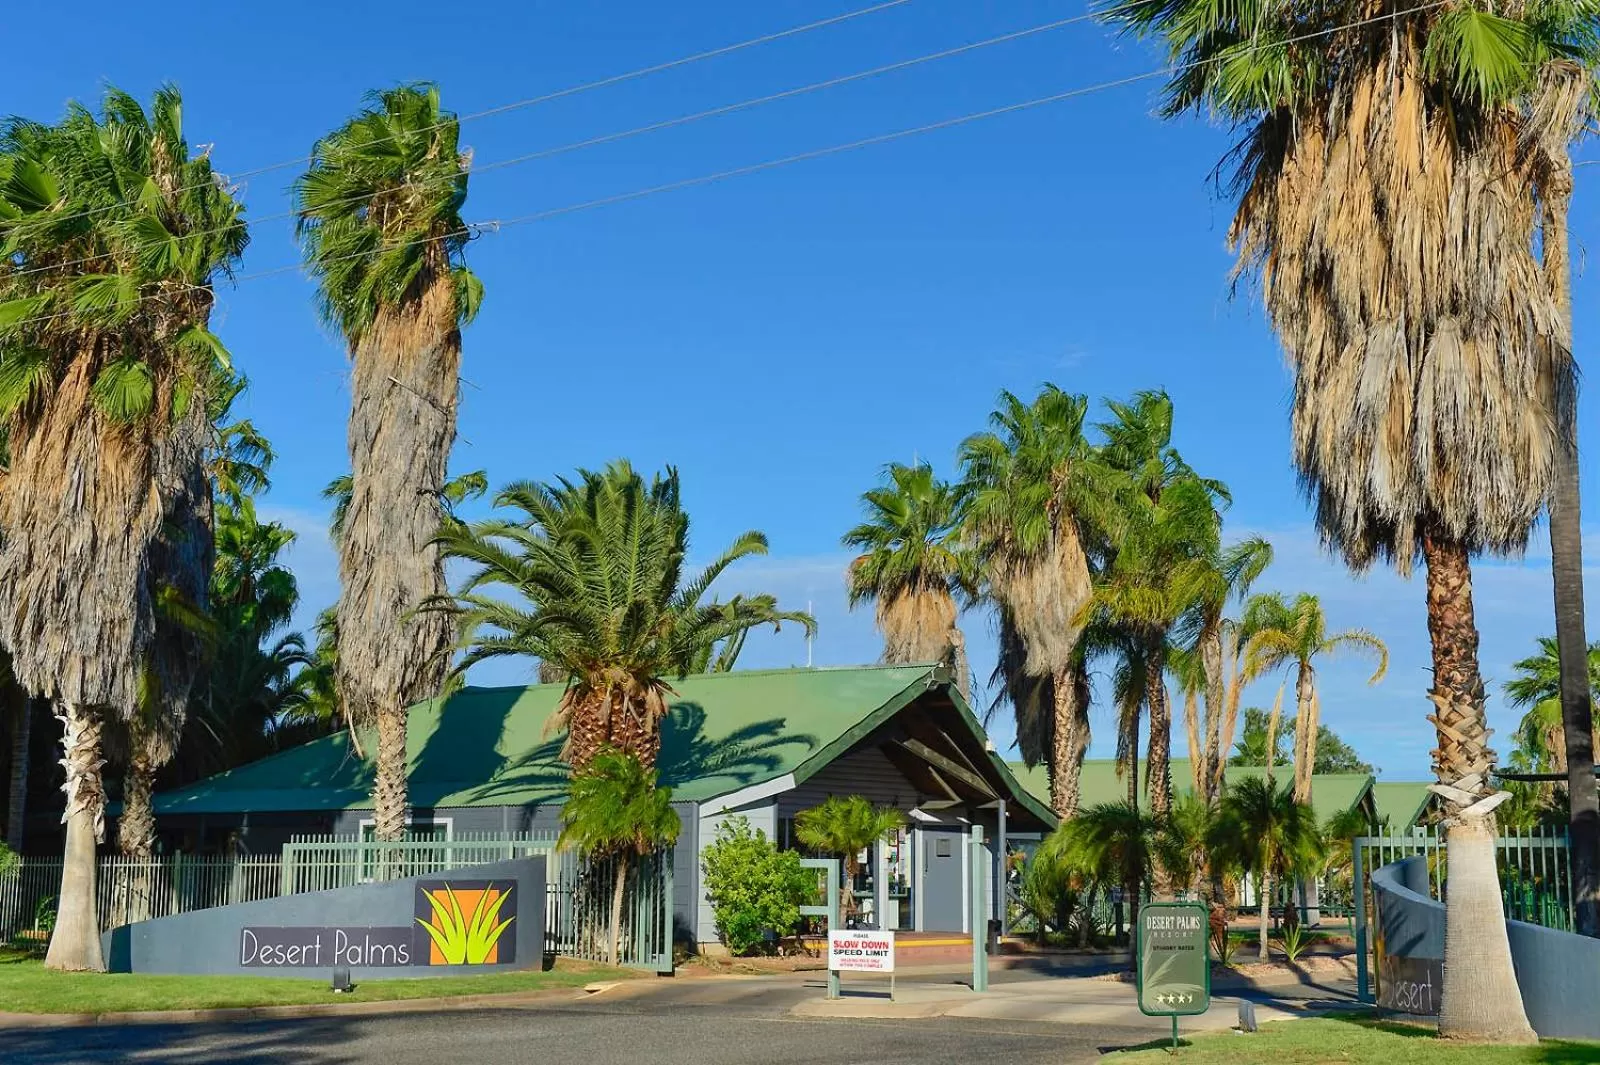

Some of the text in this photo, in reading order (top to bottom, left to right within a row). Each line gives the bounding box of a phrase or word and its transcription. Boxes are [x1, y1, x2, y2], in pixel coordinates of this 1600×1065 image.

[1146, 916, 1201, 930] DESERT PALMS
[241, 929, 410, 965] Desert Palms
[833, 940, 889, 949] SLOW DOWN
